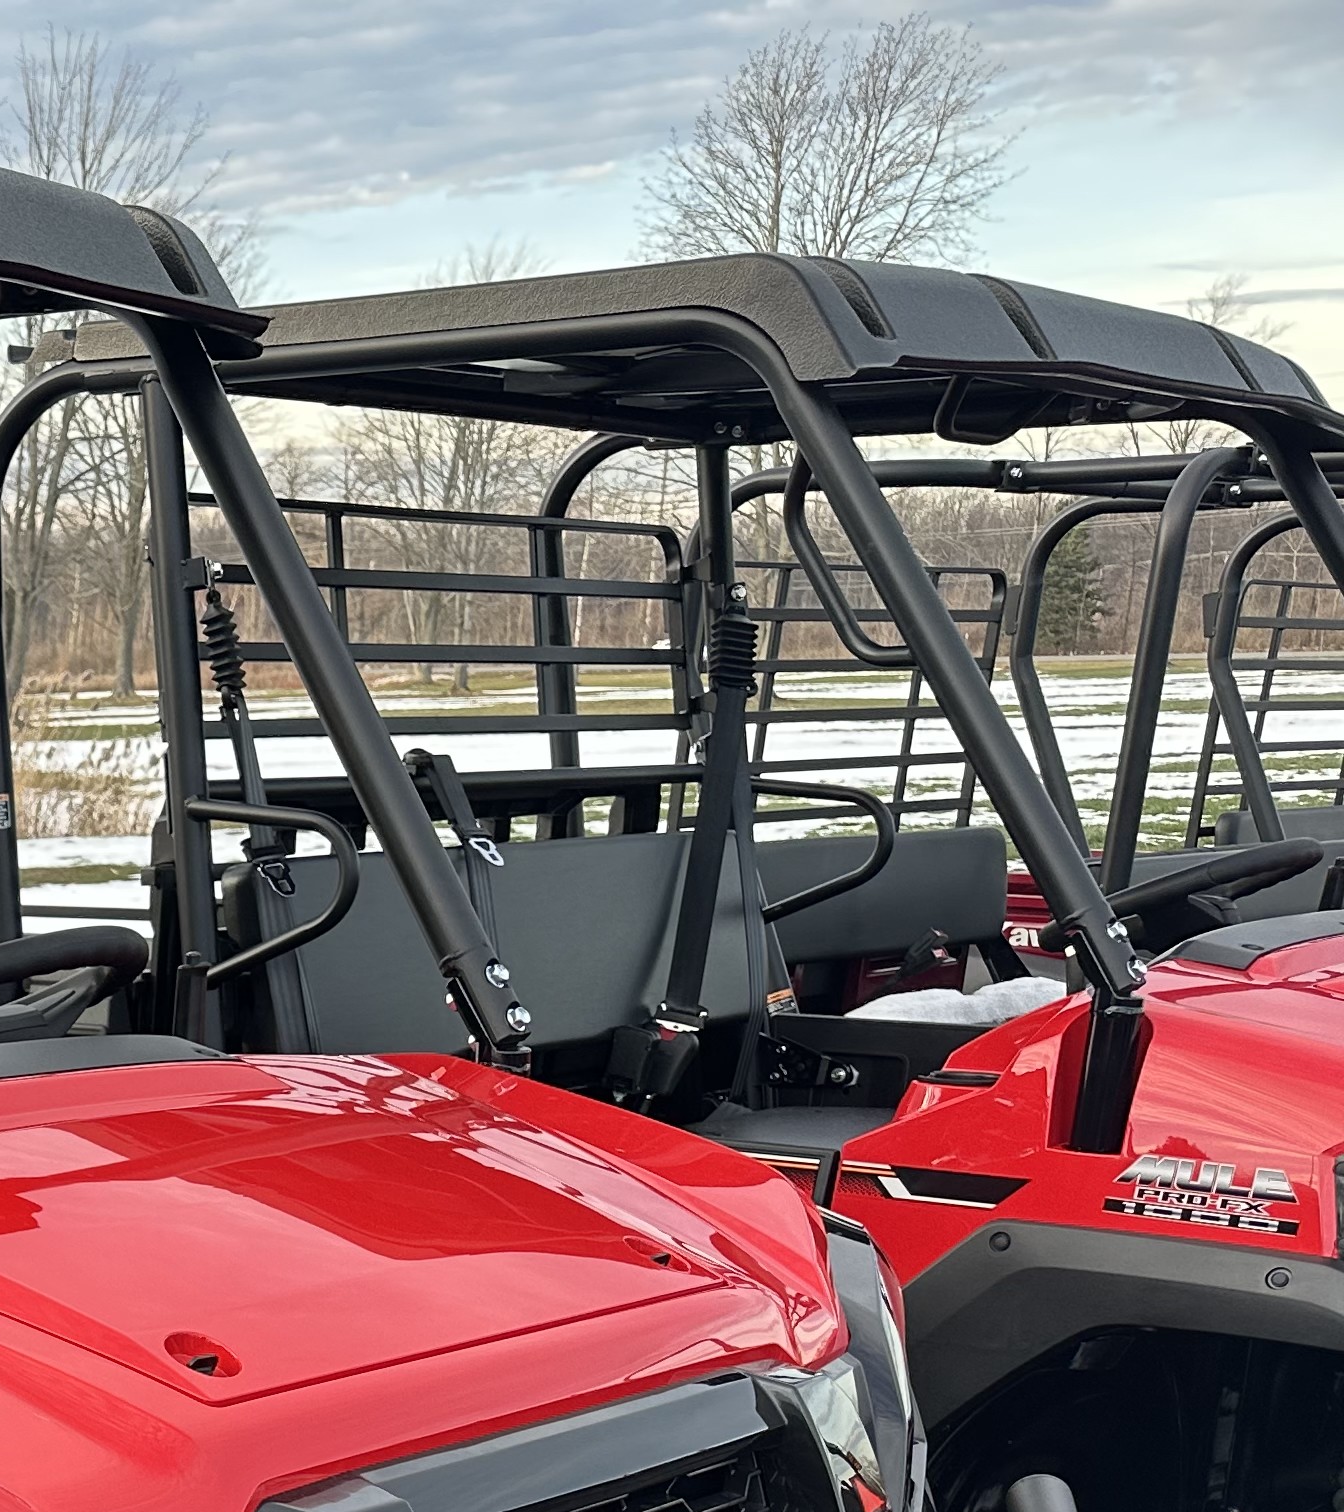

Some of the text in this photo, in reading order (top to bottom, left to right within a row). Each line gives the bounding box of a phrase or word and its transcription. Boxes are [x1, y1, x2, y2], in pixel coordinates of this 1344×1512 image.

[1113, 1154, 1300, 1204] MULE
[1121, 1201, 1280, 1233] 1000
[1134, 1186, 1273, 1217] PRO-FX
